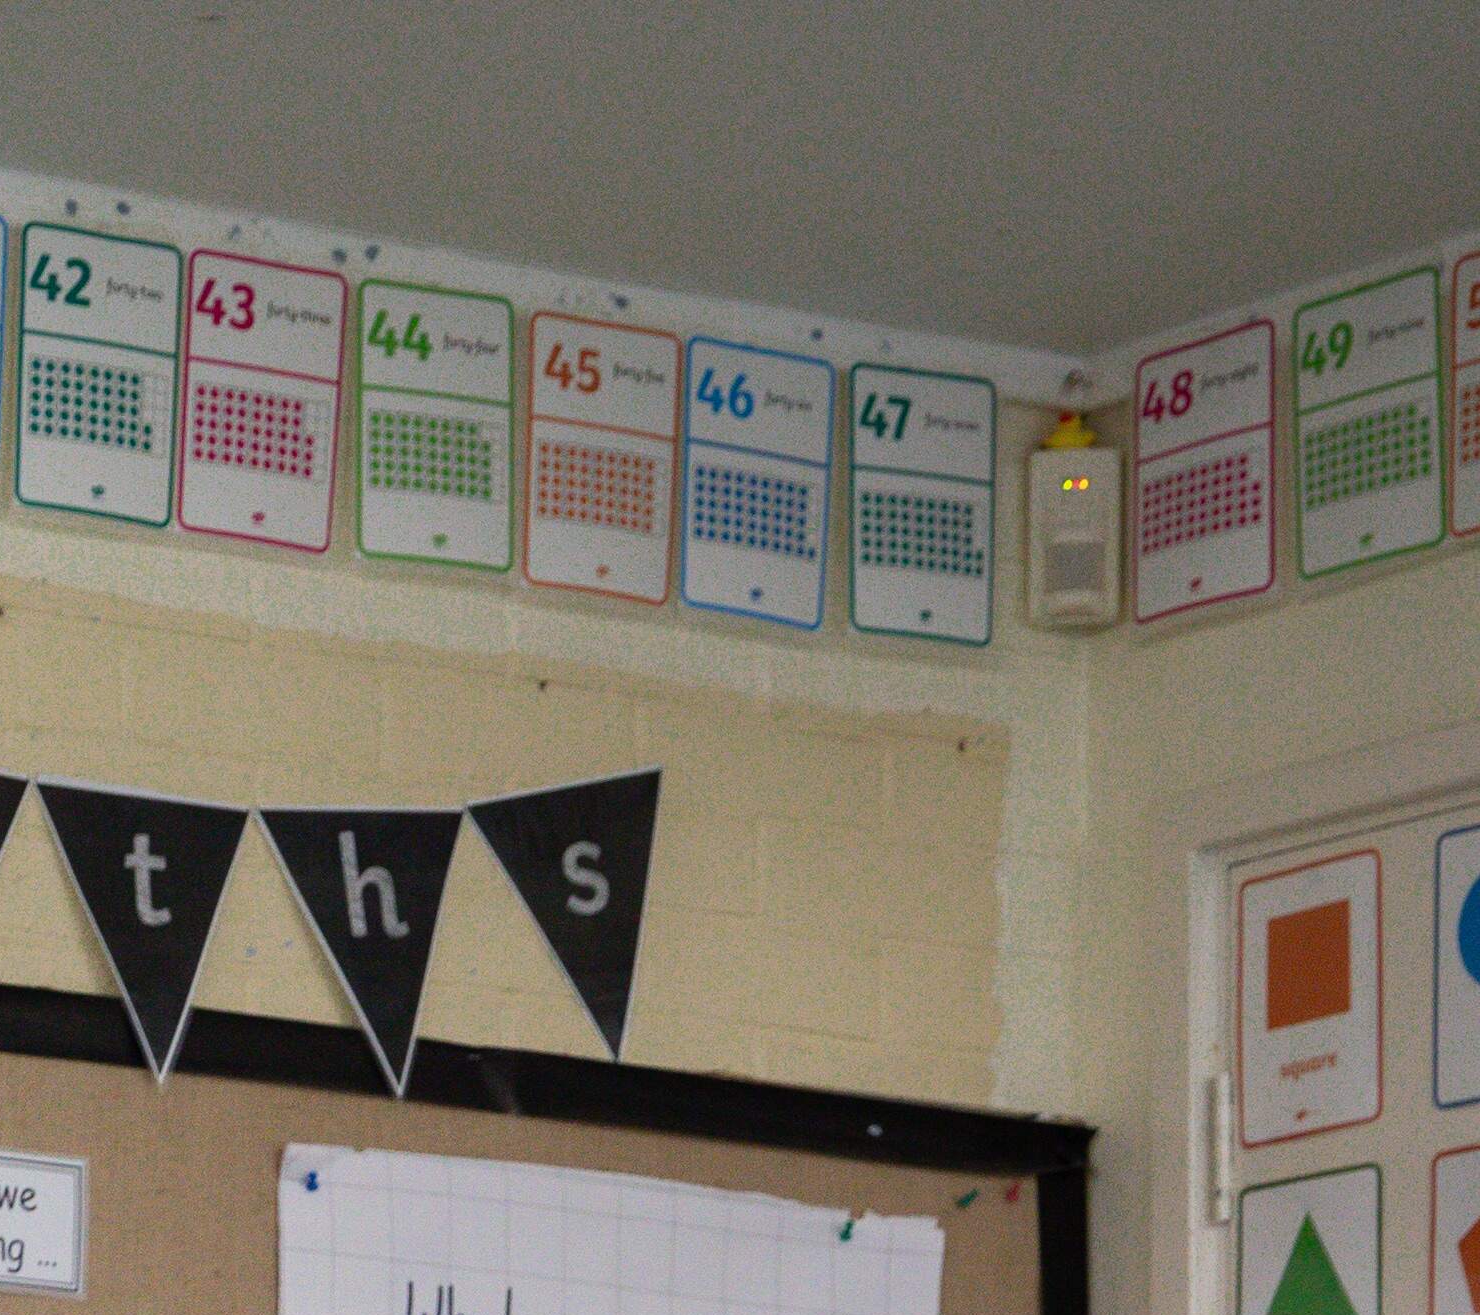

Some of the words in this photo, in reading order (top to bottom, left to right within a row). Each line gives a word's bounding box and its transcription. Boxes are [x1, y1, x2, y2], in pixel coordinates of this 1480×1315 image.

[29, 253, 92, 307] 42
[195, 278, 256, 331] 43
[367, 309, 433, 361] 44
[1300, 322, 1354, 376] 49
[544, 343, 601, 394] 45
[696, 368, 755, 419] 46
[859, 393, 912, 441] 47
[1139, 369, 1194, 423] 48
